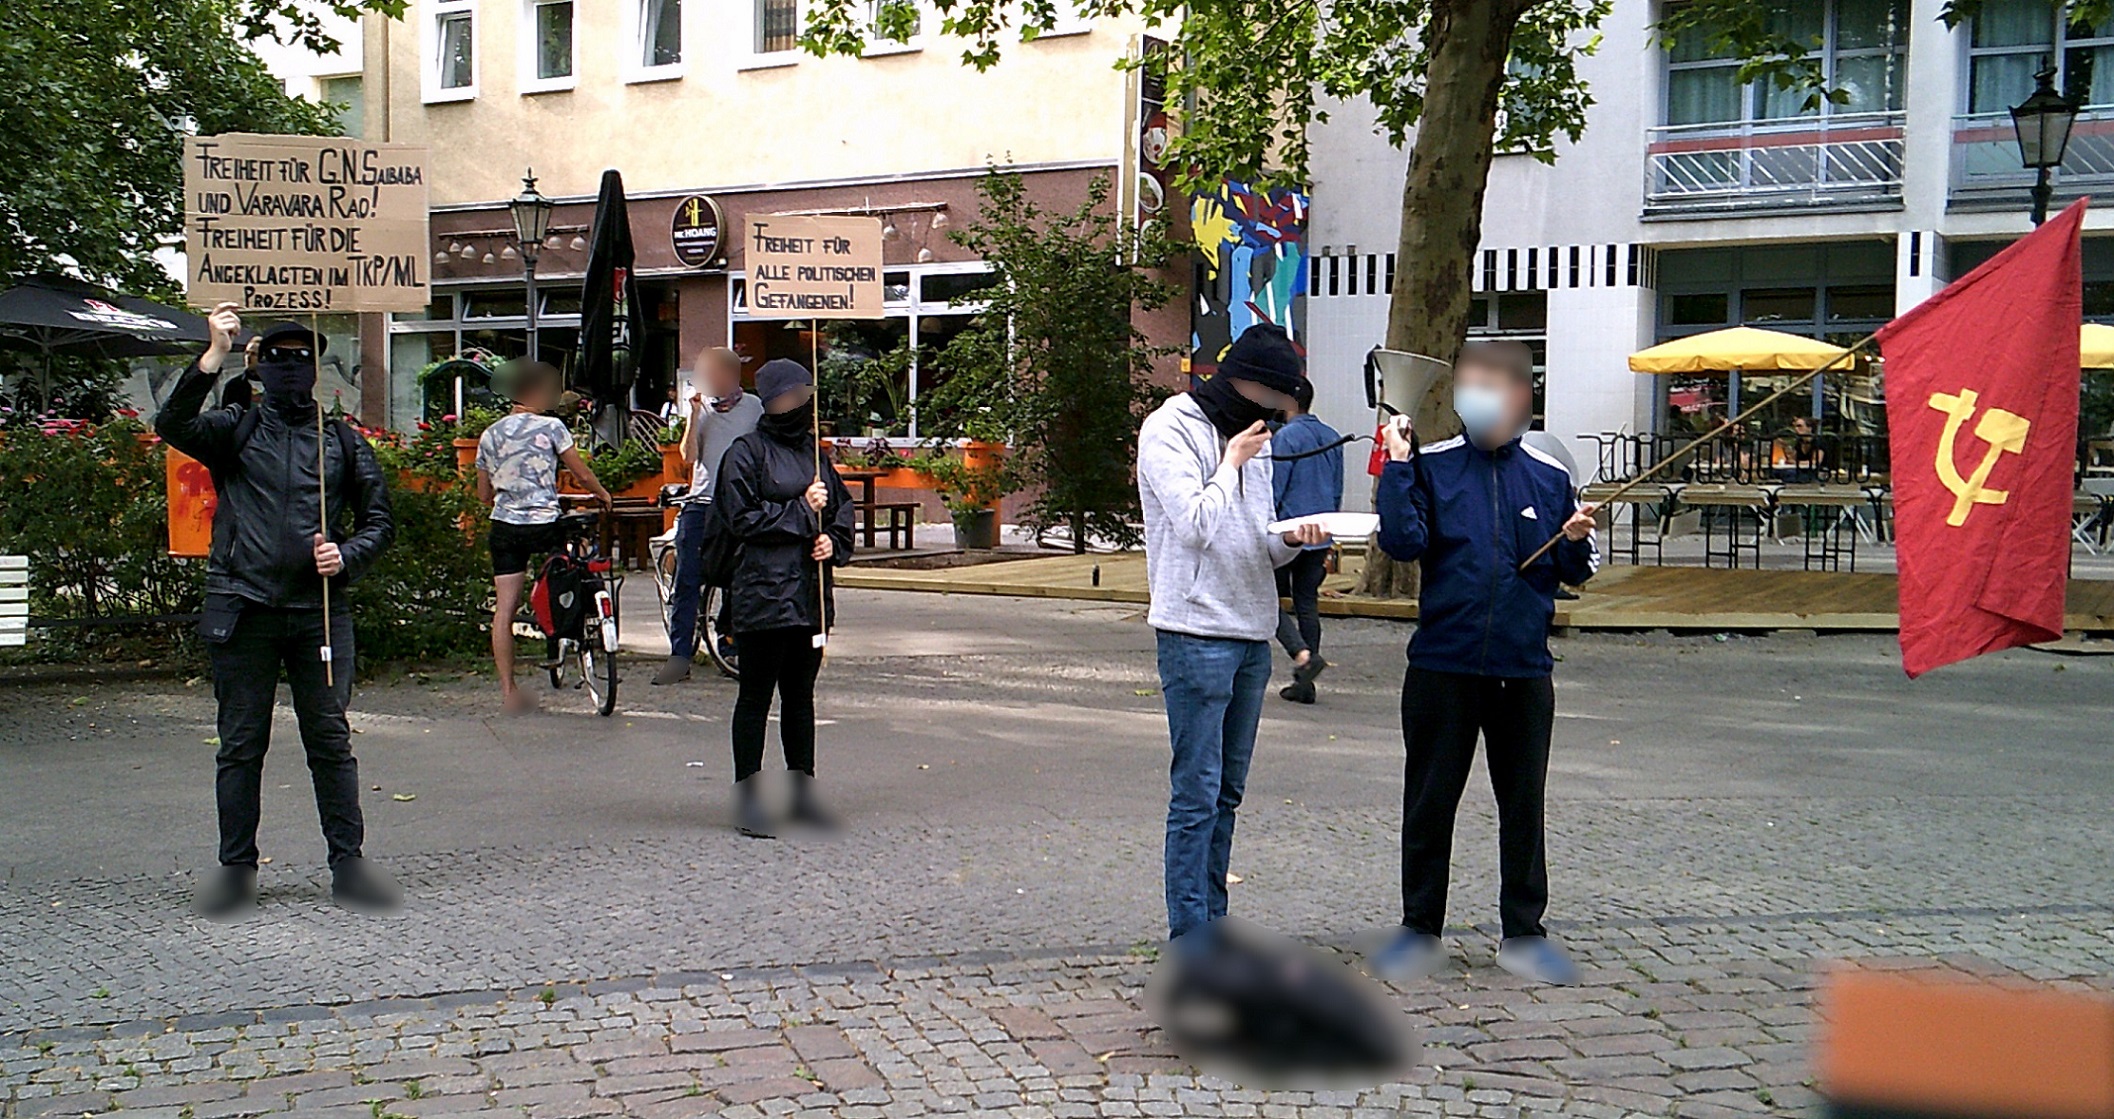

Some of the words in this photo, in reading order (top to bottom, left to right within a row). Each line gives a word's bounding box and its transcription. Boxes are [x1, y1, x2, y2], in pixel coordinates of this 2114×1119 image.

[196, 143, 275, 181] FREIHEIT
[278, 157, 311, 184] FÜR
[198, 192, 231, 214] UND
[235, 183, 325, 218] VARAVARA
[329, 186, 378, 219] RAO!
[196, 217, 287, 249] FREIHEIT
[291, 223, 328, 253] FÜR
[331, 227, 362, 253] DIE
[753, 223, 815, 253] FREIHEIT
[822, 236, 851, 254] FÜR
[197, 253, 323, 286] ANGEKLAGTEN
[328, 267, 348, 287] IM
[346, 255, 426, 288] TKP/ML
[755, 264, 791, 281] ALLE
[797, 265, 876, 282] POLITISCHEN
[243, 286, 332, 310] PROZESS!
[754, 282, 855, 310] GEFANGENEN!
